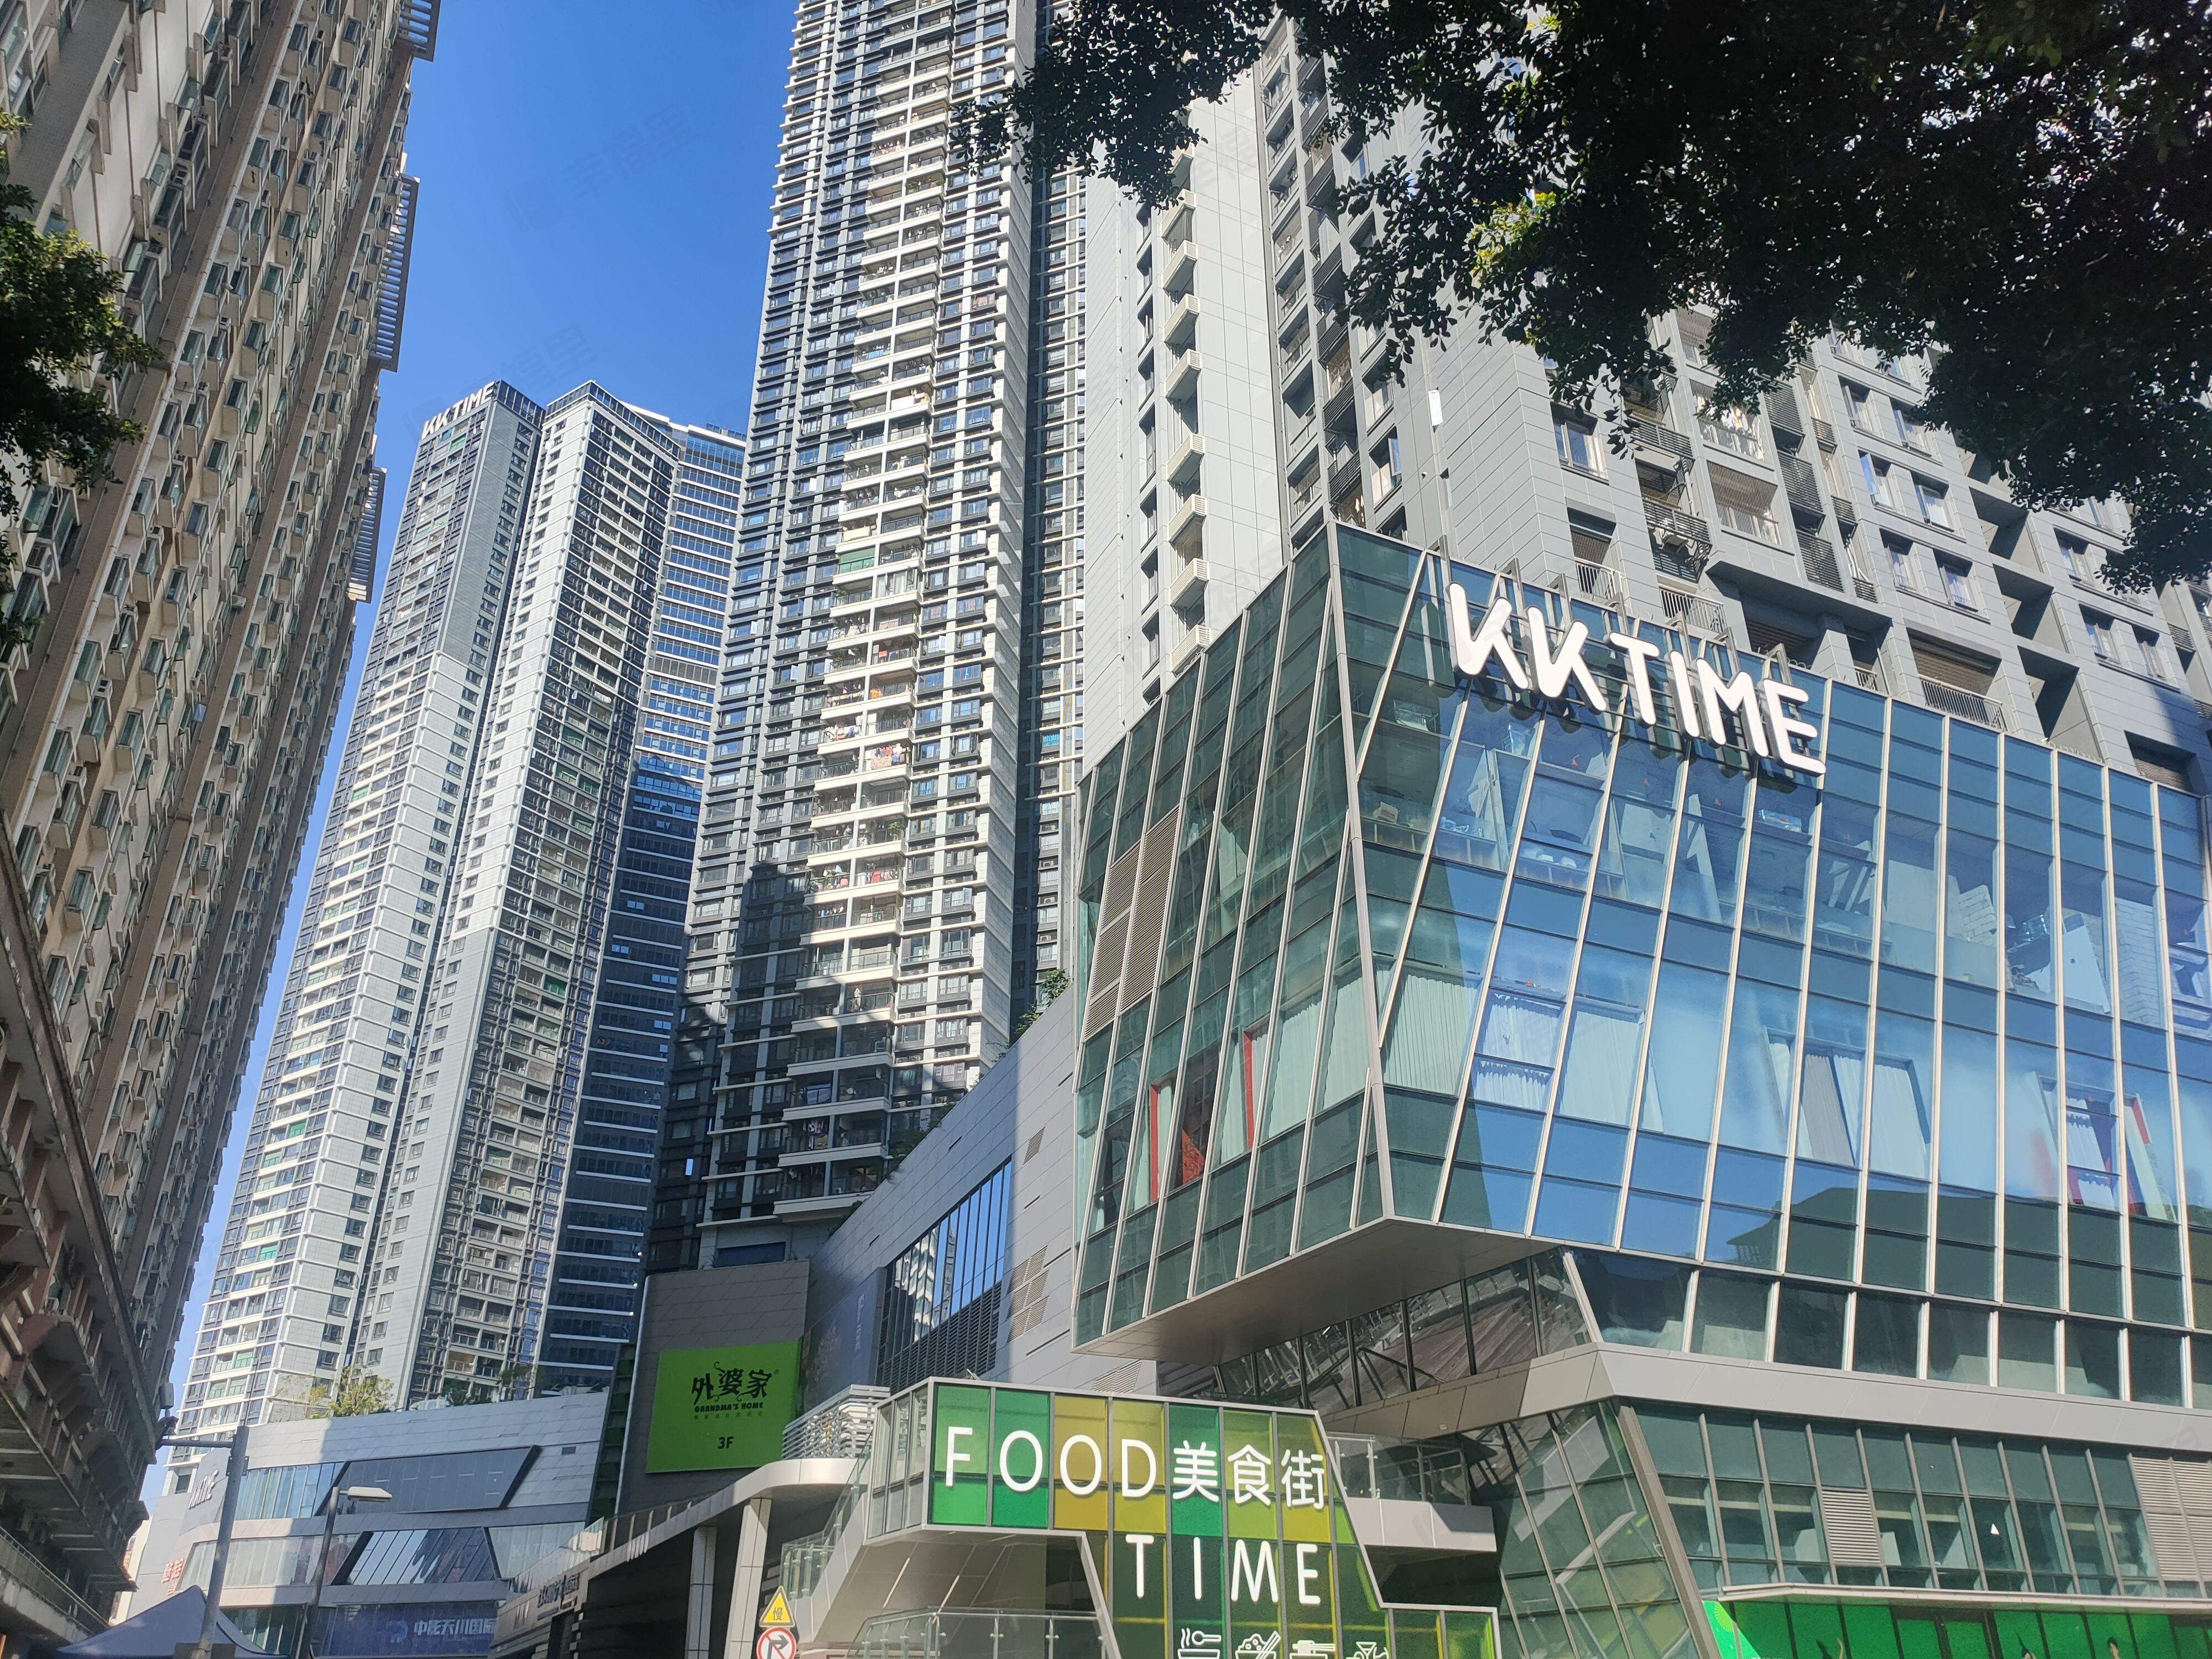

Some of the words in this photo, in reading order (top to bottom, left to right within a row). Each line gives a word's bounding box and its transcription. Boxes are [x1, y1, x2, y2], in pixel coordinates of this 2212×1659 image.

[691, 1361, 772, 1405] 外婆家
[718, 1436, 734, 1449] 3F
[945, 1426, 1157, 1499] FOOD
[1172, 1440, 1326, 1510] 美食街
[1125, 1533, 1322, 1605] TIME
[773, 1606, 783, 1621] 慢
